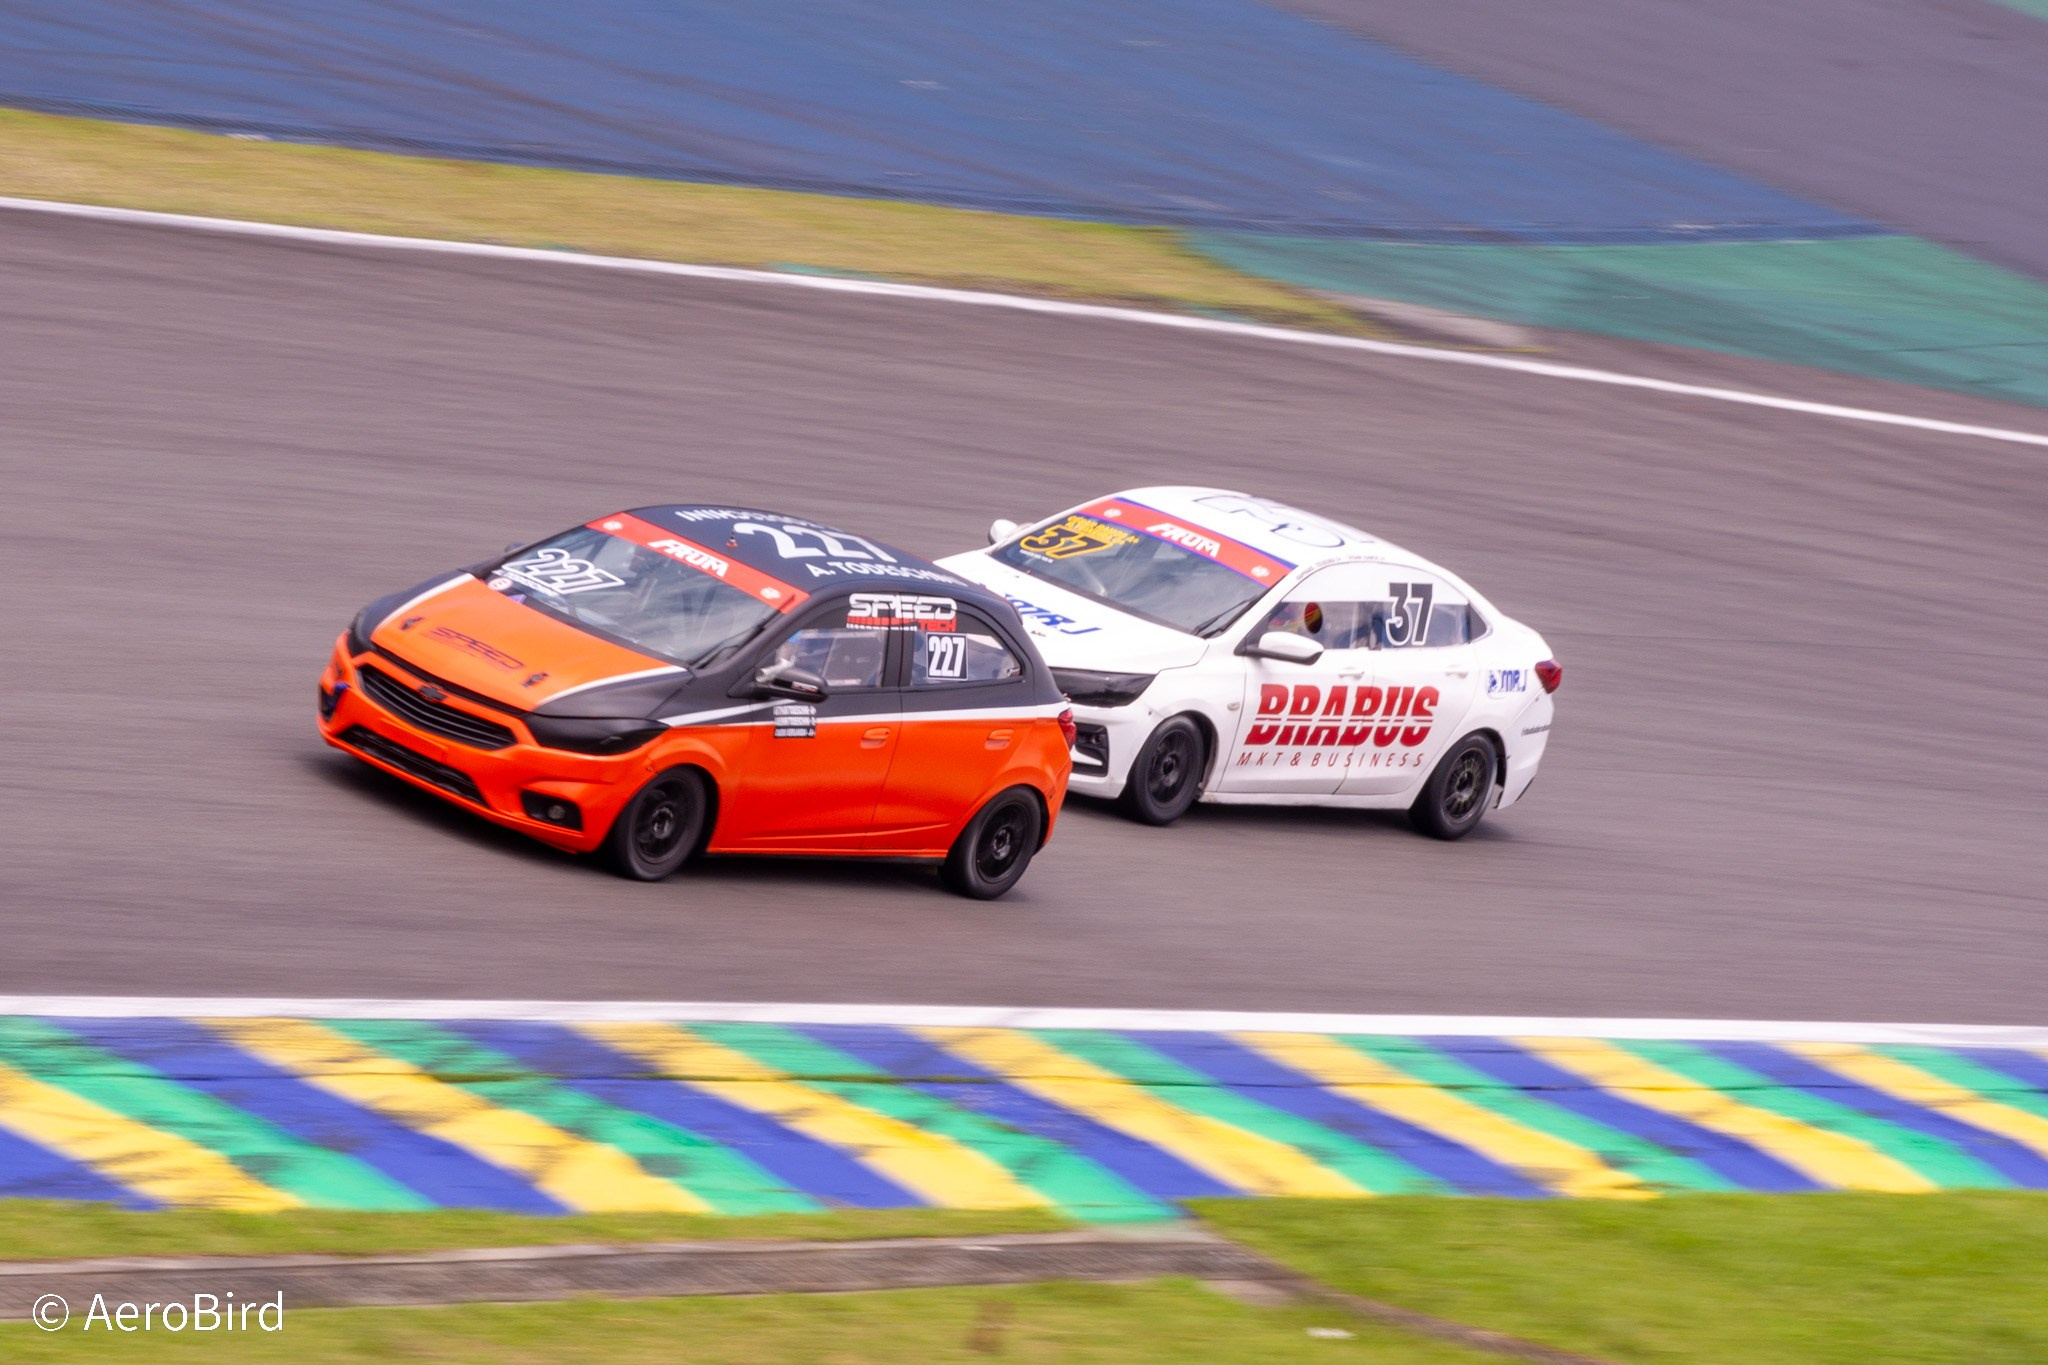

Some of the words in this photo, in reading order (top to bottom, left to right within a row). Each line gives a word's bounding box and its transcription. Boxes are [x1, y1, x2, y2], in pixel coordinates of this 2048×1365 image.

[733, 522, 898, 563] 227
[1020, 525, 1114, 559] 37
[501, 548, 626, 595] 227
[847, 593, 957, 620] SPEED
[919, 618, 957, 632] TECH
[1385, 582, 1433, 647] 37
[928, 636, 965, 678] 227
[1244, 683, 1440, 747] BRABUS
[1236, 752, 1283, 767] MKT
[1290, 752, 1301, 767] &
[1311, 752, 1424, 767] BUSINESS
